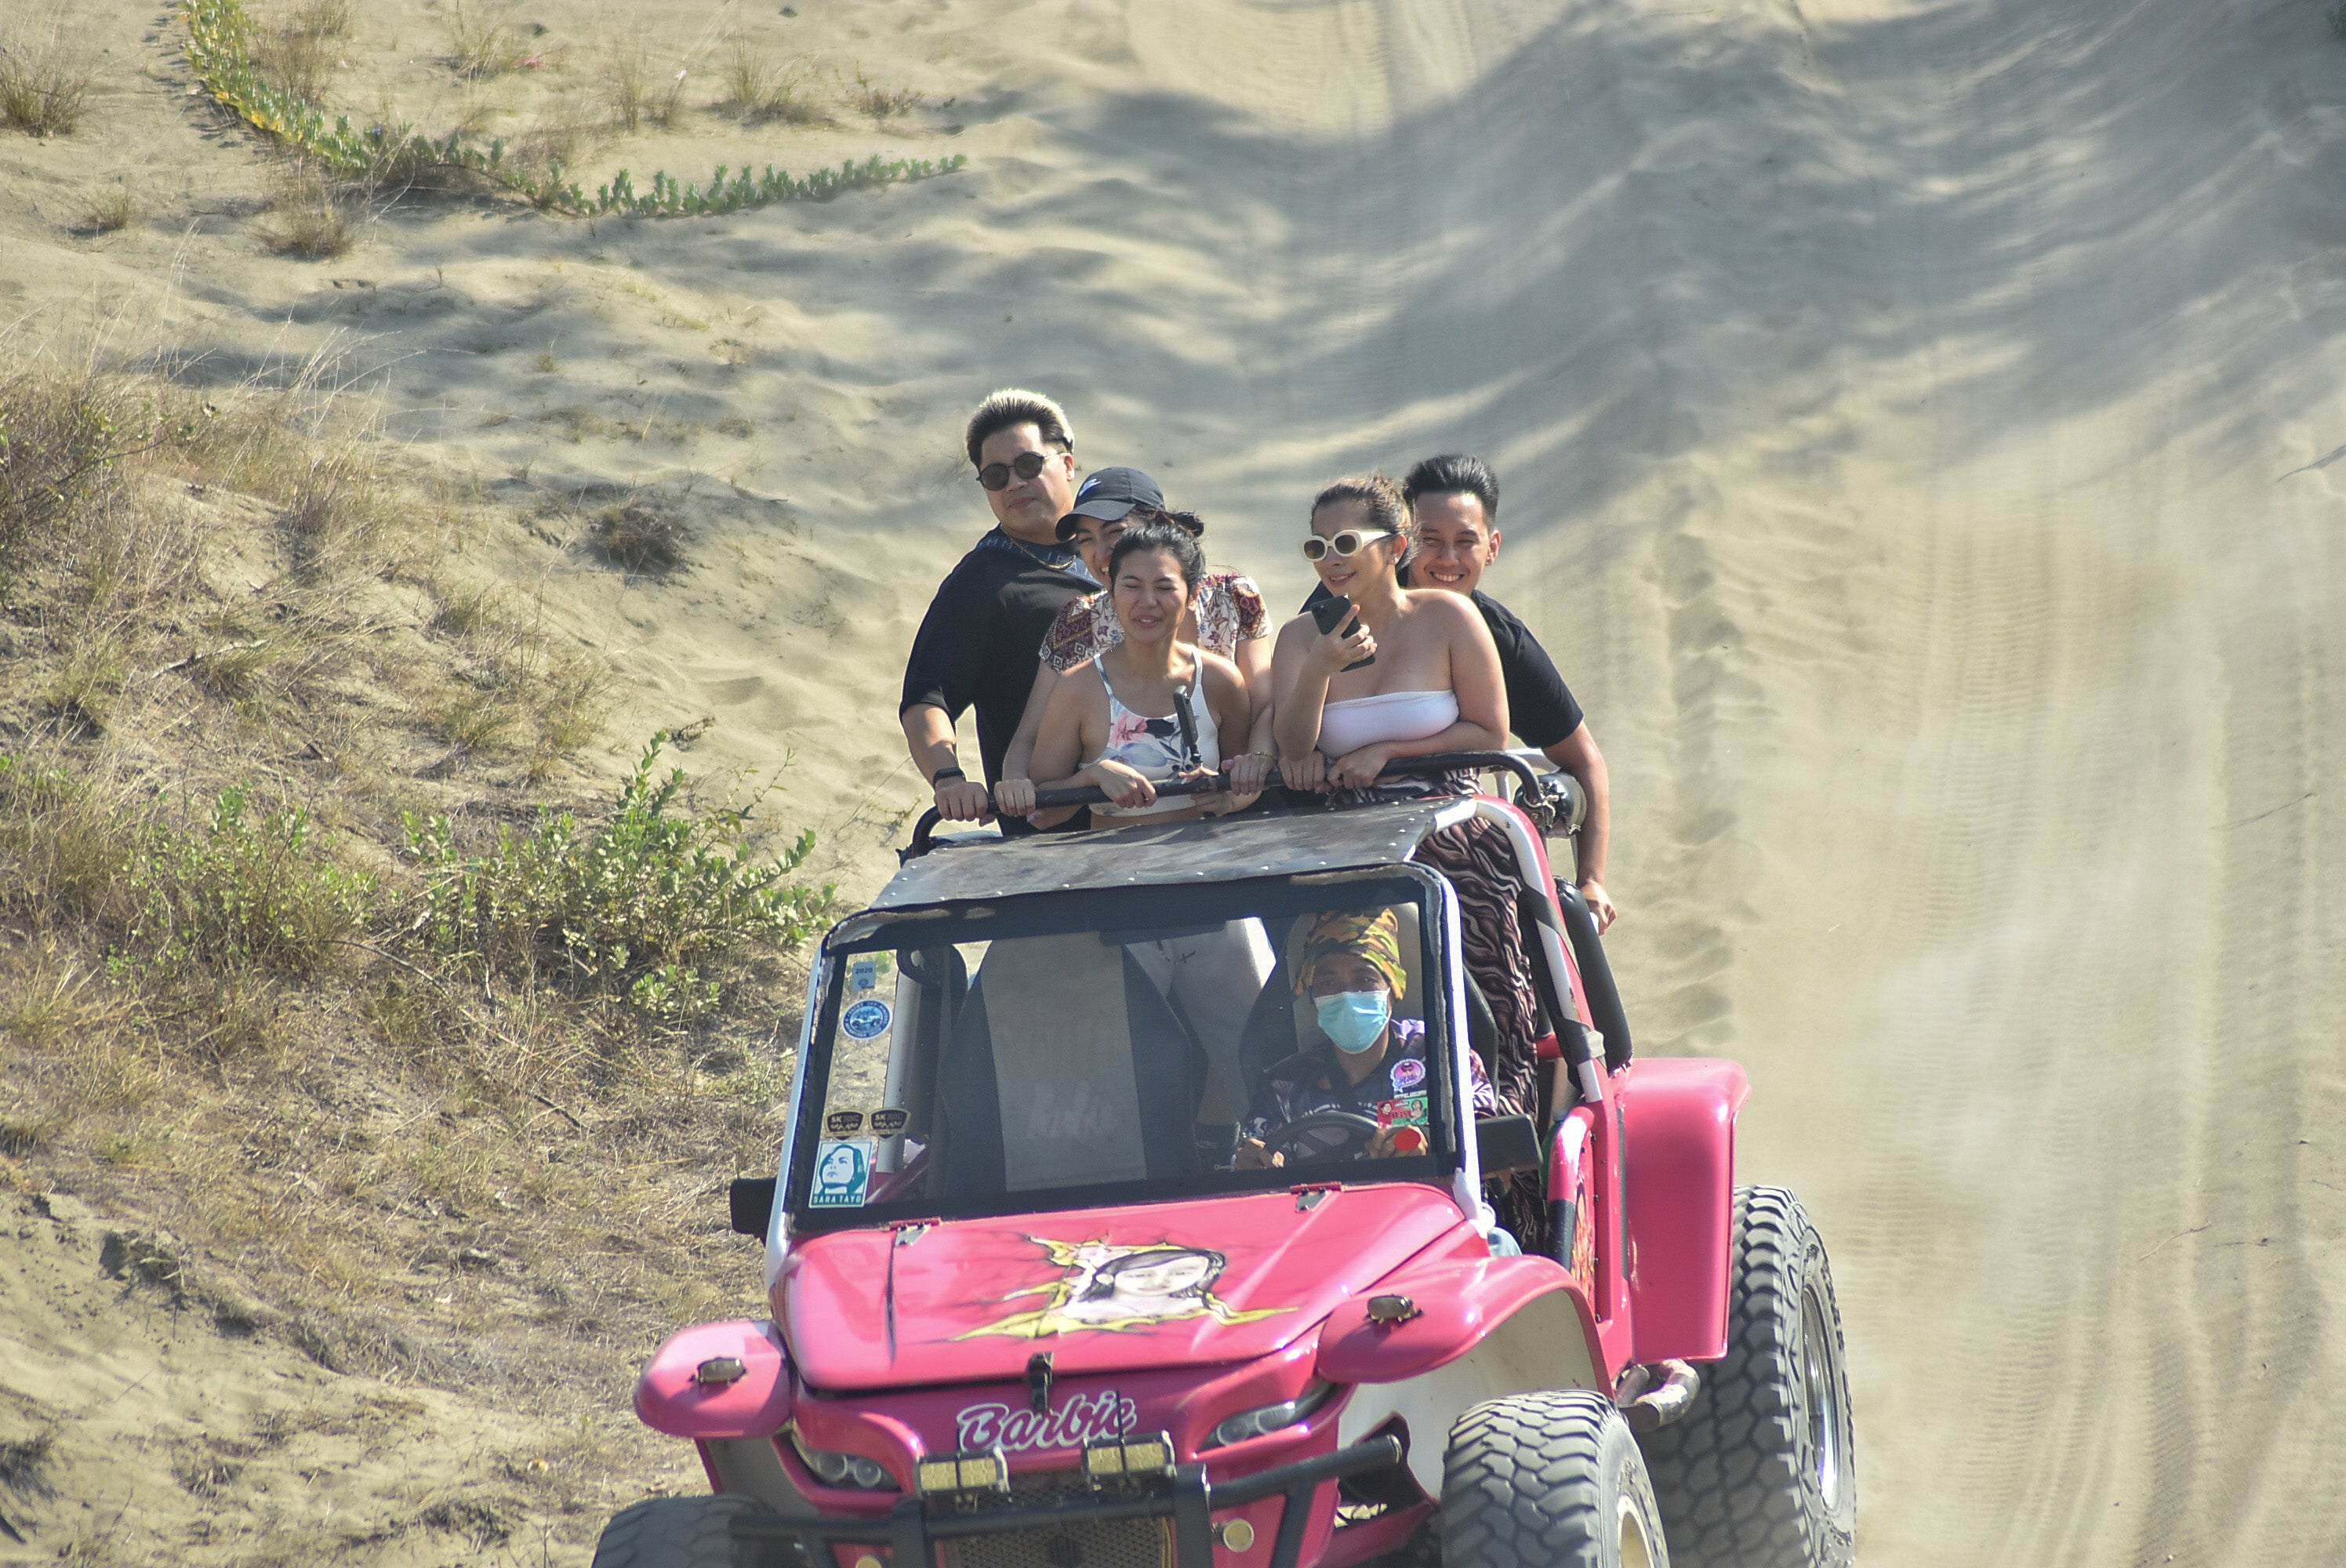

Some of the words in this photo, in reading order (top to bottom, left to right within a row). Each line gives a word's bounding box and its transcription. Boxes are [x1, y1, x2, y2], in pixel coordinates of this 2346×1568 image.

[813, 1195, 836, 1203] SARA
[839, 1195, 862, 1203] TAYO
[957, 1390, 1138, 1452] Barbie
